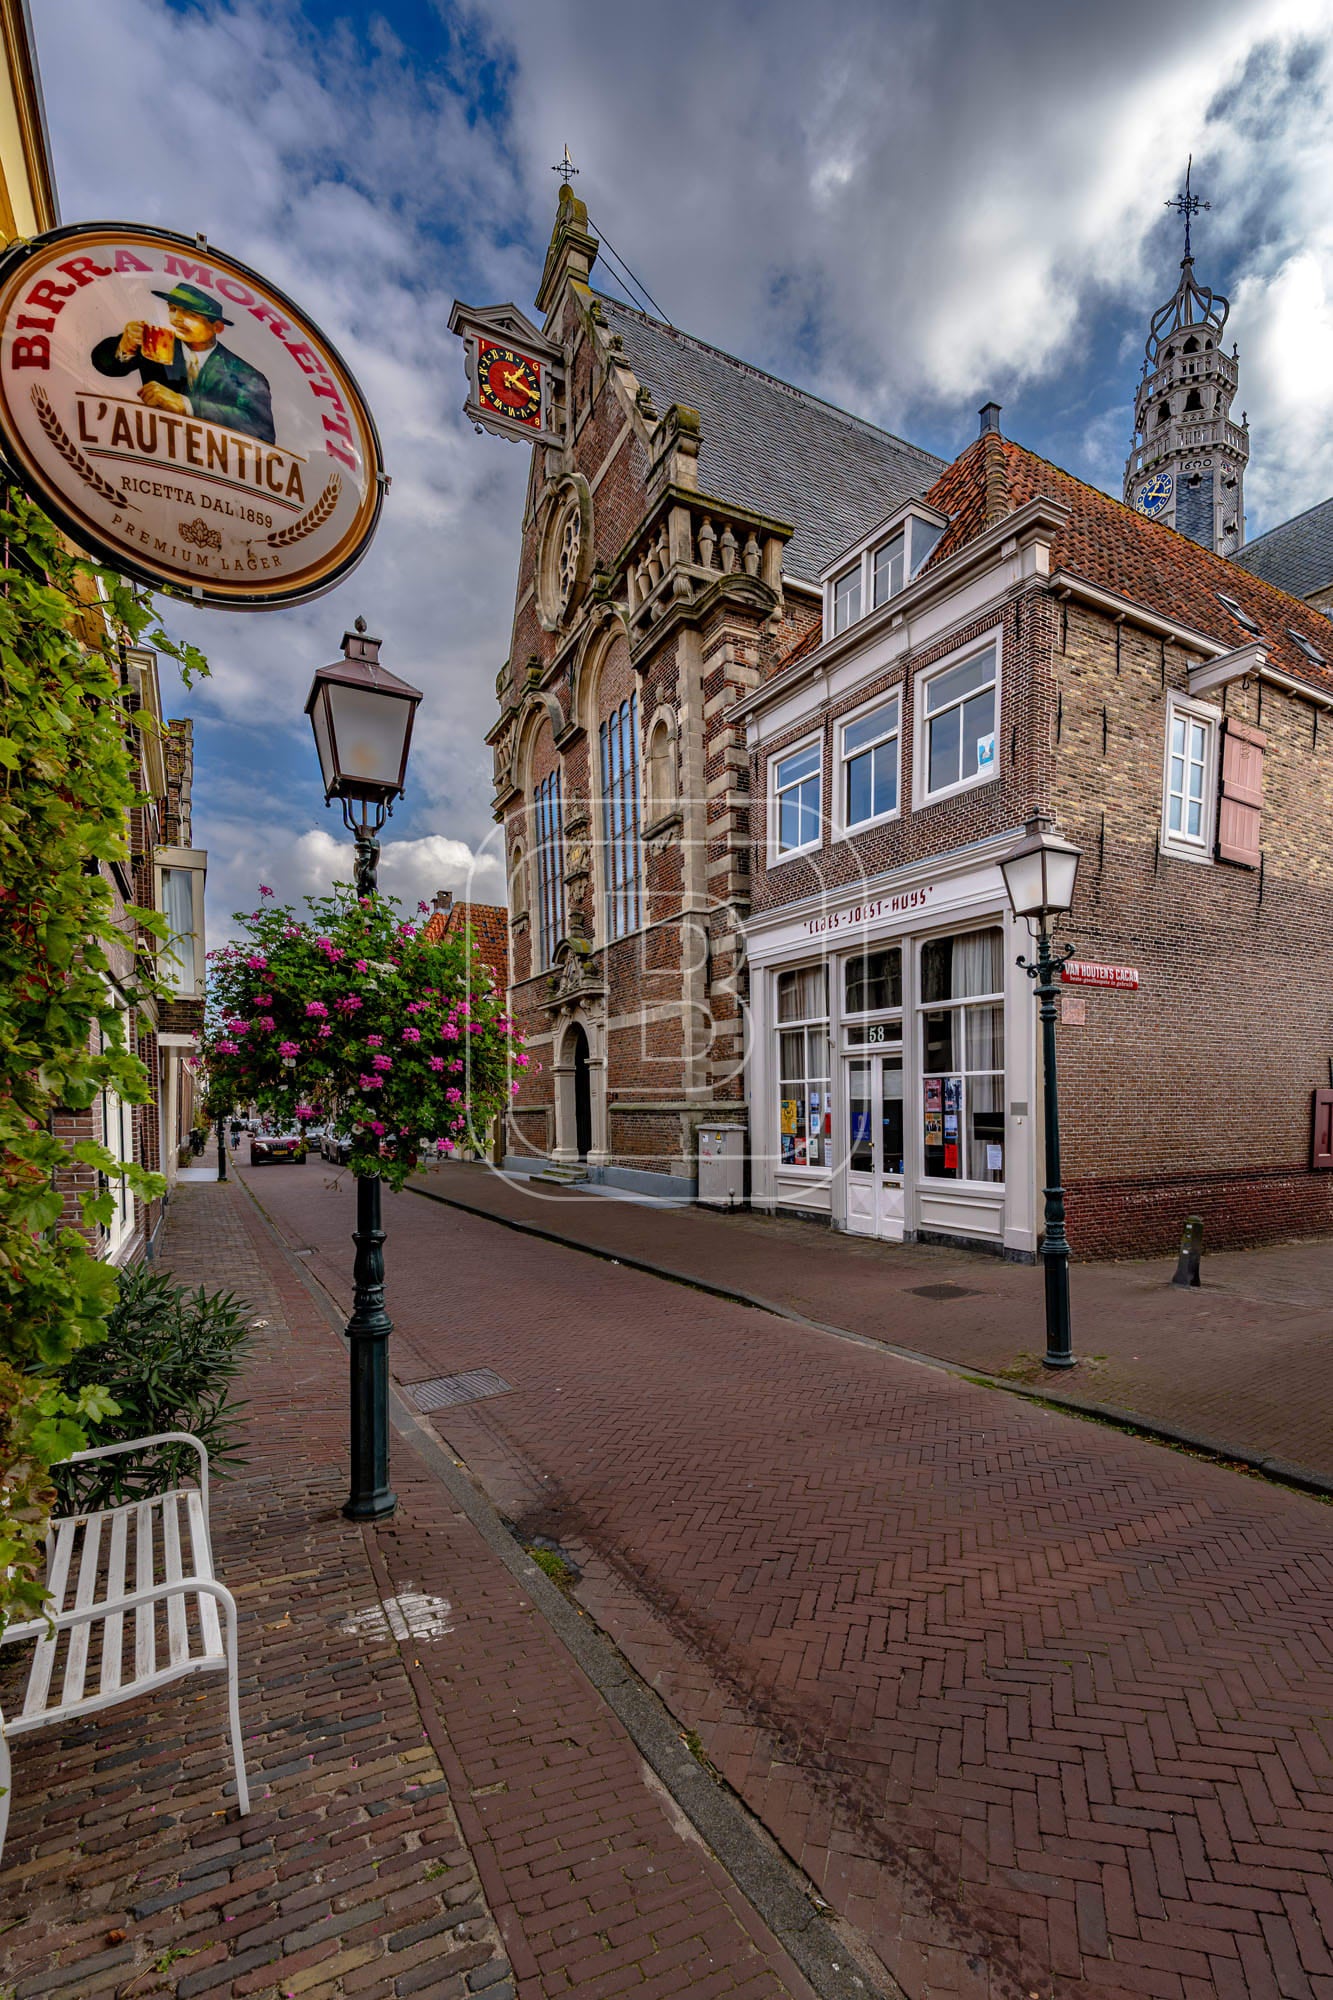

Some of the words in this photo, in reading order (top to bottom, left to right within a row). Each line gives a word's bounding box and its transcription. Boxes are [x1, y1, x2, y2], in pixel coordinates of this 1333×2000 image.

[11, 249, 154, 370] BIRRA
[163, 253, 356, 472] MORETTI
[482, 356, 491, 365] X
[533, 363, 539, 371] 6
[480, 396, 485, 404] 8
[535, 418, 540, 426] 8
[77, 400, 305, 504] L'AUTENTICA
[120, 476, 196, 505] RICETTA
[200, 494, 234, 516] DAL
[239, 505, 273, 529] 1859
[111, 513, 209, 566] PREMIUM
[221, 555, 283, 571] LAGER
[1064, 962, 1080, 976] VAN
[1081, 964, 1114, 980] HOUTEN'S
[1115, 968, 1139, 983] CACAO
[869, 1025, 885, 1043] 58
